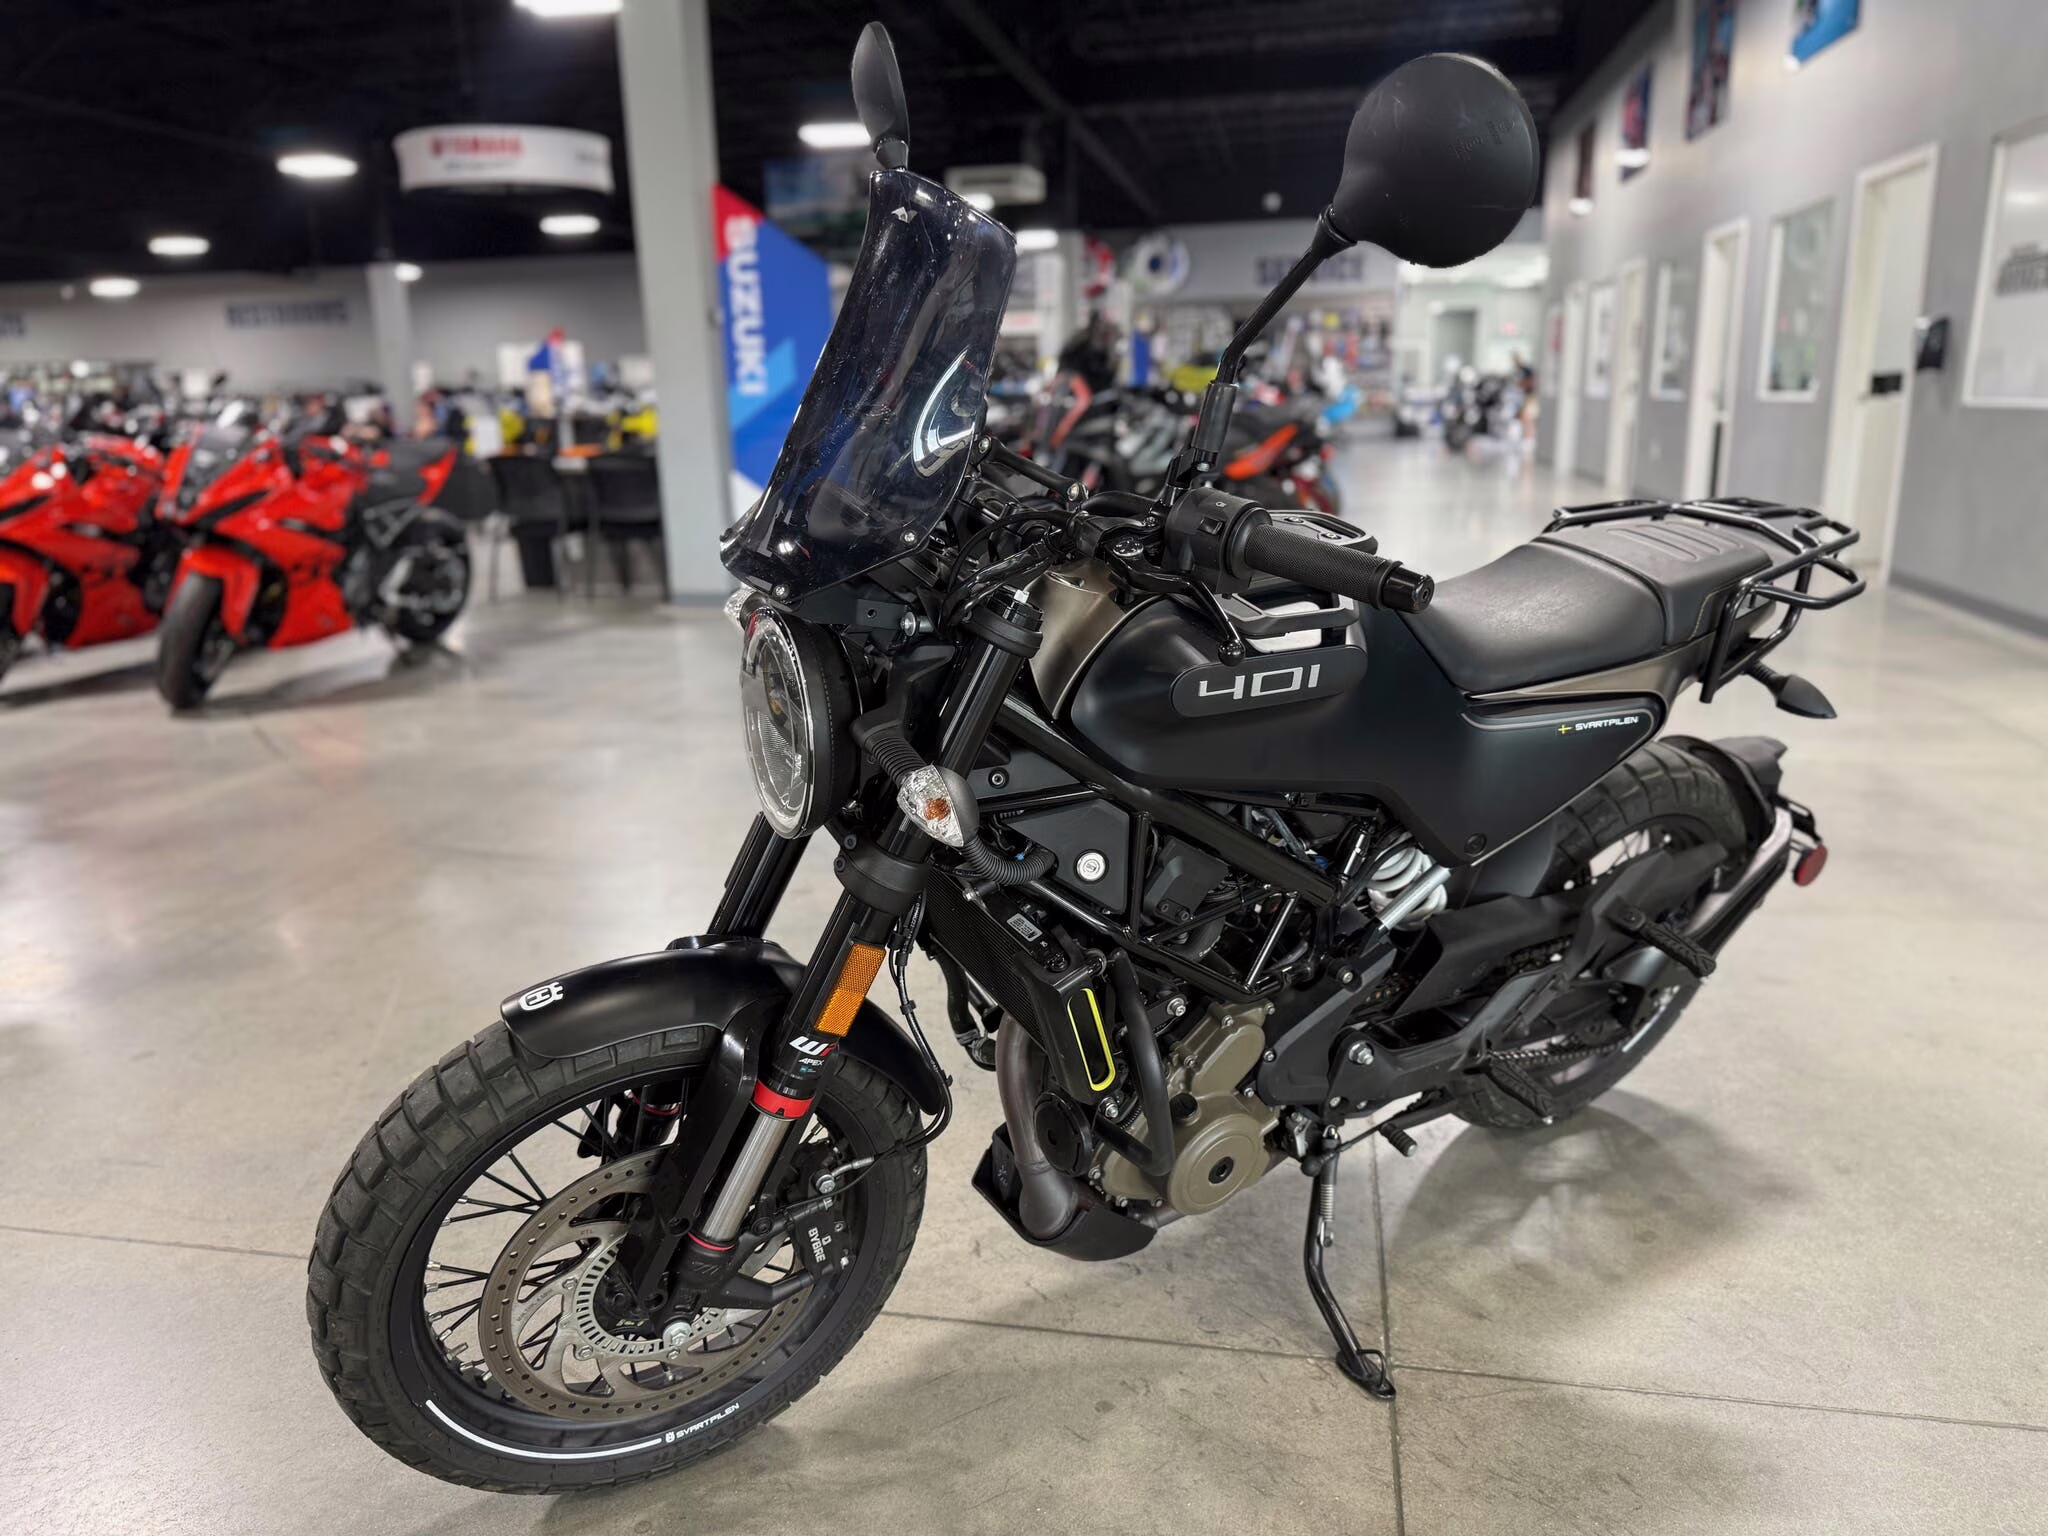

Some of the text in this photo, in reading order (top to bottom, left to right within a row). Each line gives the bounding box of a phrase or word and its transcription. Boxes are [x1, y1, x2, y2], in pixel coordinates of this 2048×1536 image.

[724, 214, 768, 396] SUZUKI
[1198, 664, 1320, 700] 401
[1575, 716, 1639, 731] SVARTPILEN
[798, 1057, 825, 1066] APEX
[808, 1227, 826, 1263] BYBRE
[676, 1402, 740, 1438] SVARTPILEN
